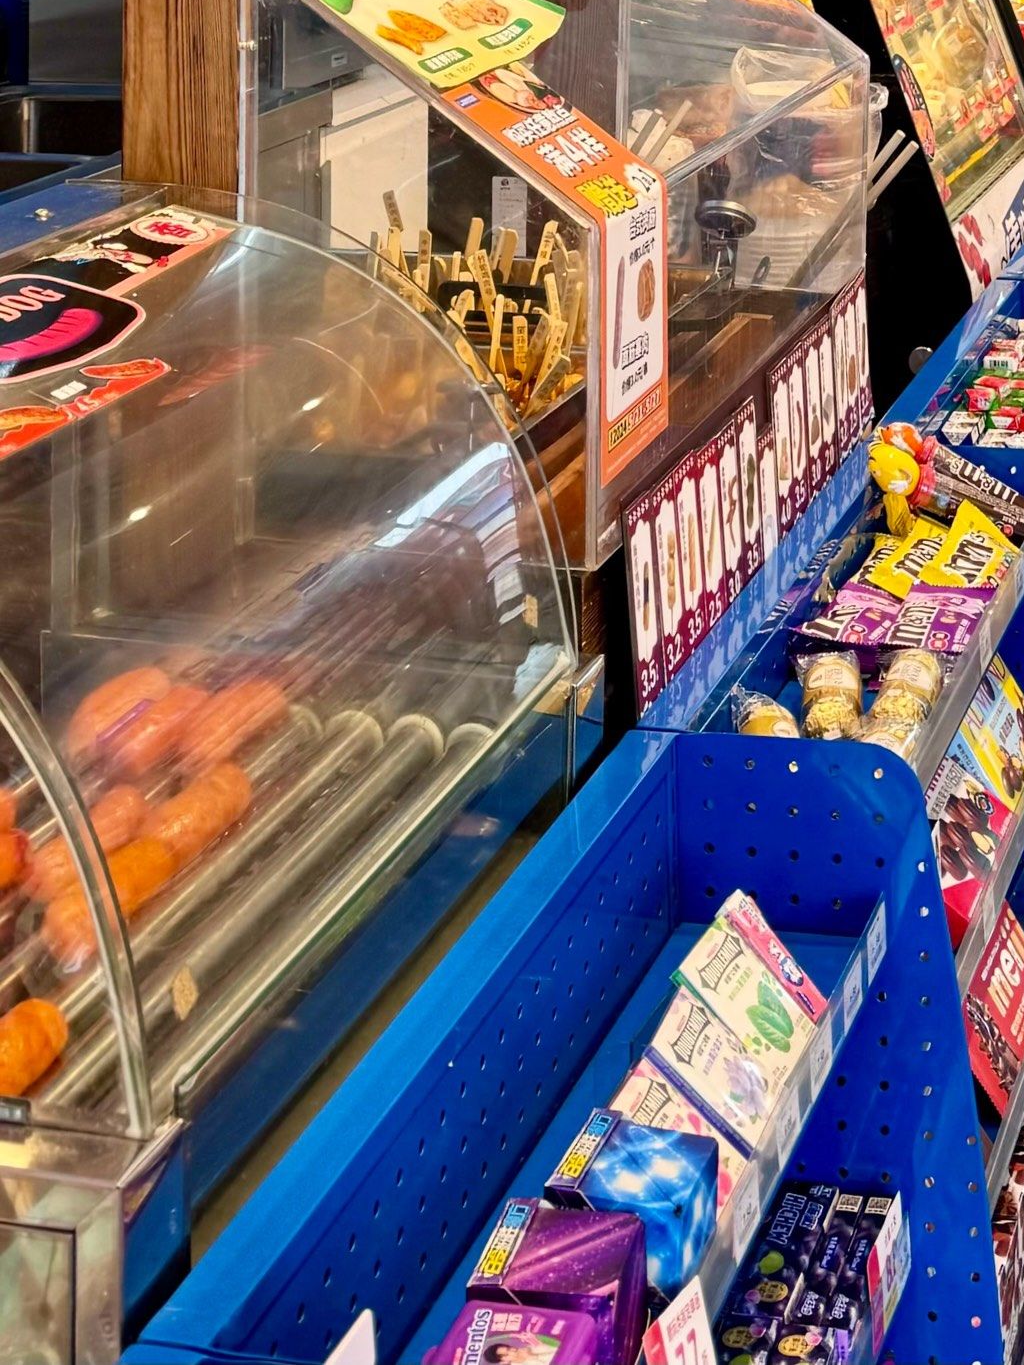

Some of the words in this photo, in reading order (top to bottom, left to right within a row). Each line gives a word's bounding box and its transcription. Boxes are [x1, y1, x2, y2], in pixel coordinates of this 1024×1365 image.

[747, 543, 759, 575] 3.5
[728, 570, 741, 604] 3.0
[688, 608, 703, 645] 3.5
[709, 591, 723, 628] 2.5
[667, 633, 683, 671] 3.2
[641, 660, 657, 698] 3.5
[463, 1307, 492, 1365] mentos
